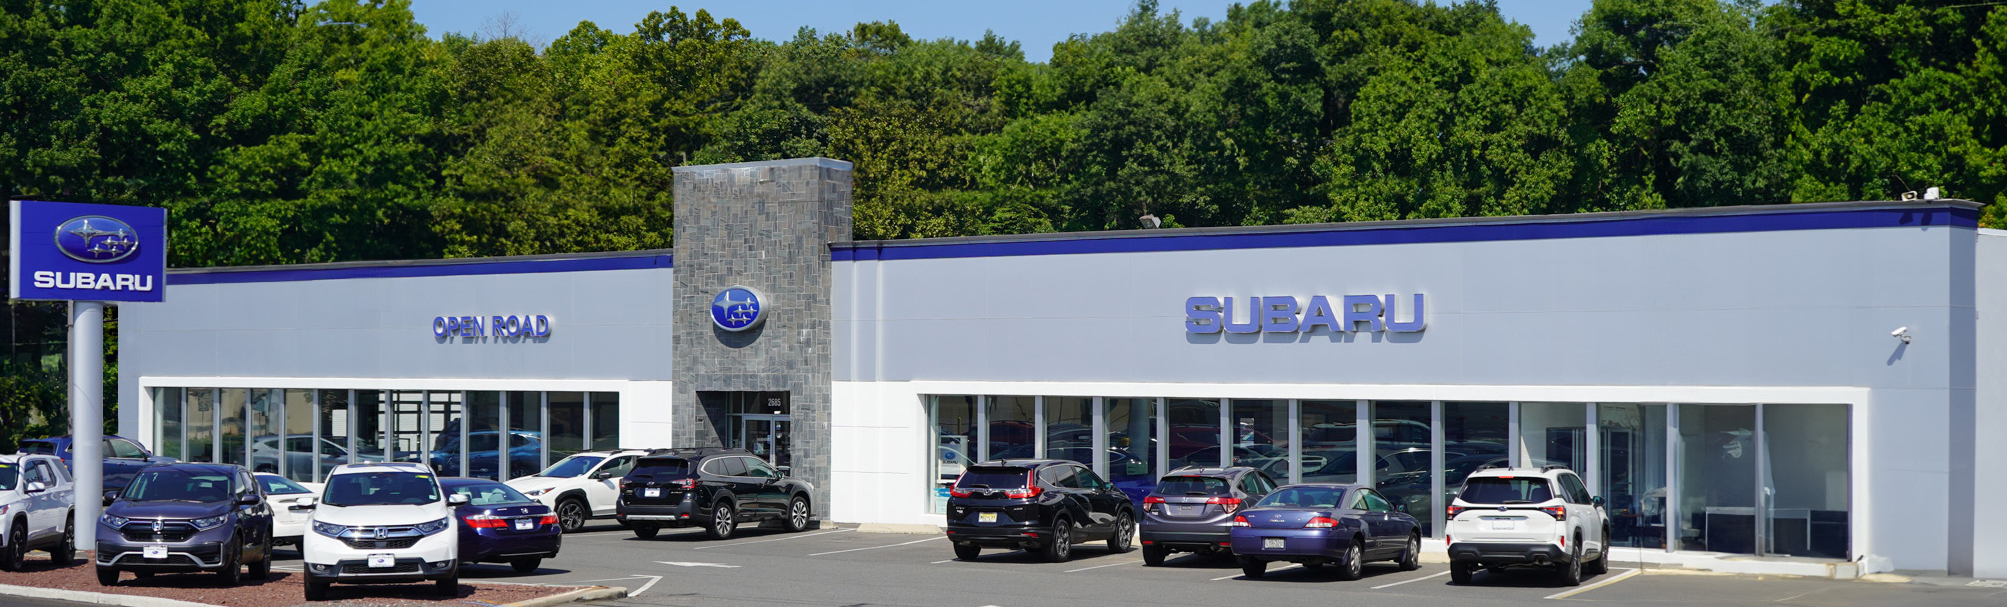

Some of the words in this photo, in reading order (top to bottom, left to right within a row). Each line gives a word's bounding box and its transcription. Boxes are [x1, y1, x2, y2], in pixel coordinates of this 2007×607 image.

[33, 270, 153, 291] SUBARU
[1185, 294, 1426, 333] SUBARU
[432, 316, 486, 337] OPEN
[492, 315, 551, 337] ROAD
[767, 398, 781, 407] 2685
